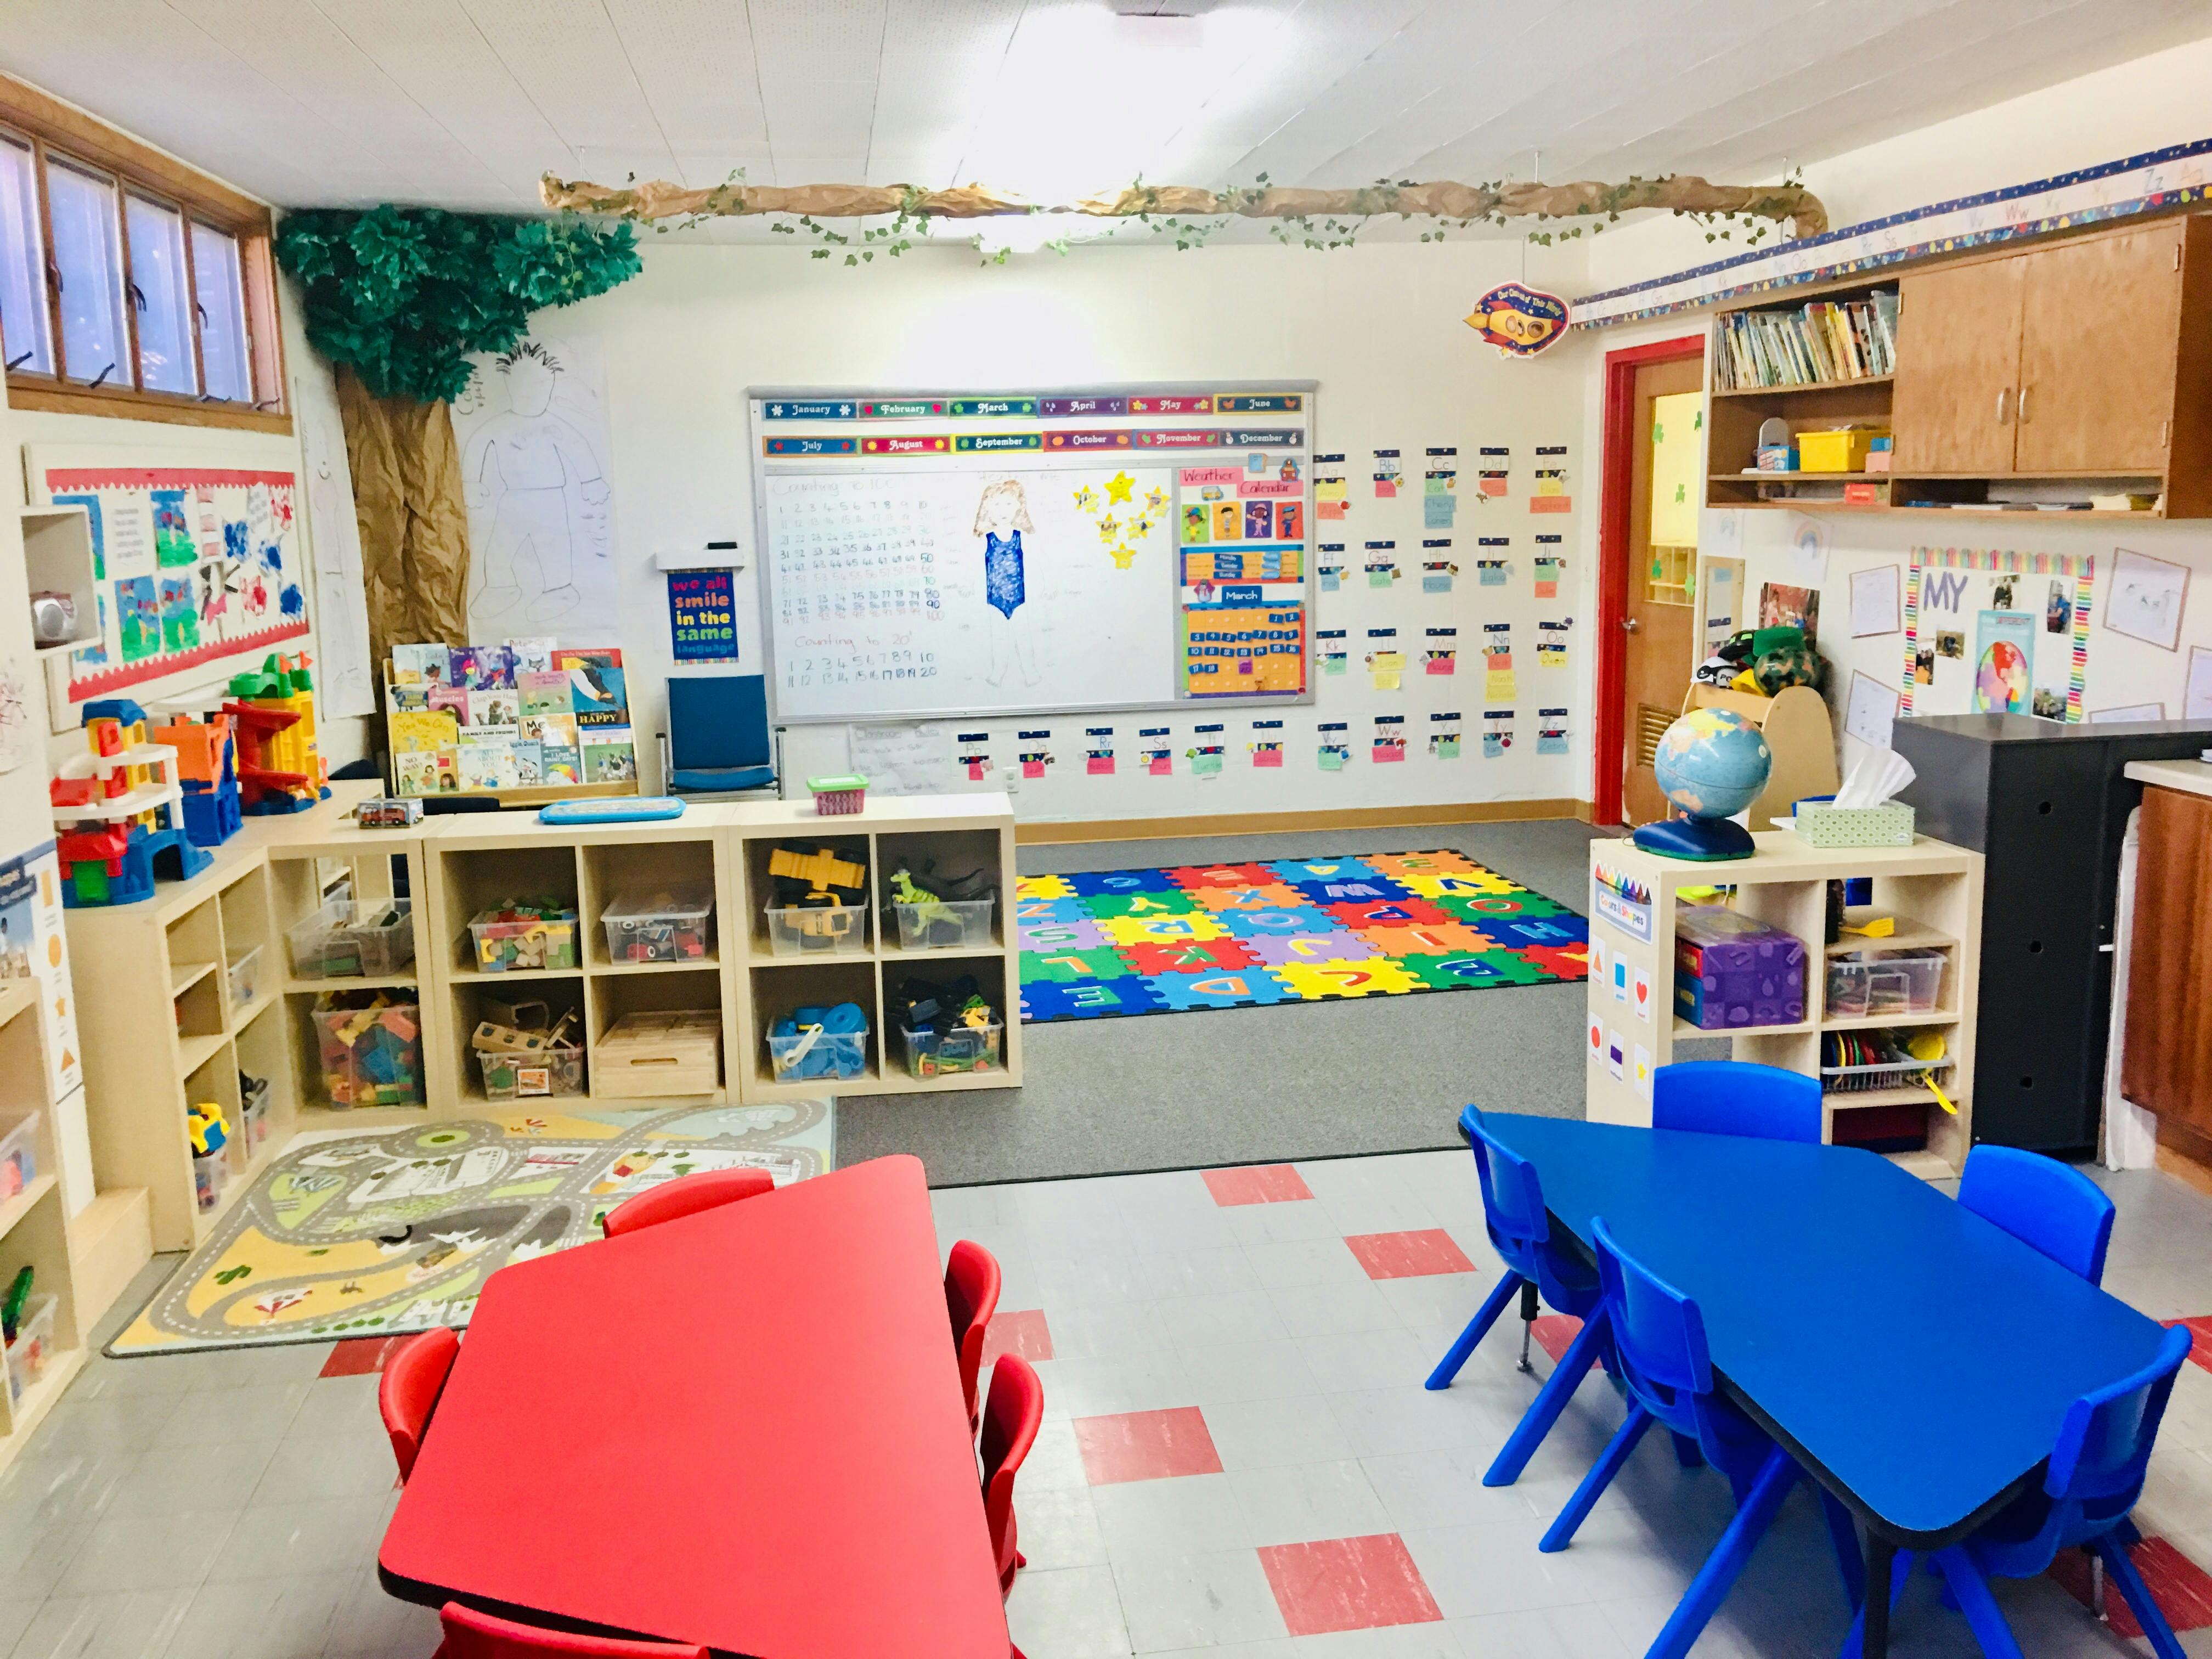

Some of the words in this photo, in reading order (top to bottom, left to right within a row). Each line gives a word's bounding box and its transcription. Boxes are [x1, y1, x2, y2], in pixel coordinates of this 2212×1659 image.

[2143, 168, 2164, 193] Zz
[792, 405, 830, 415] January
[881, 404, 926, 416] February
[978, 403, 1008, 413] March
[1070, 401, 1096, 411] April
[1160, 400, 1181, 410] May
[1249, 399, 1271, 408] June
[802, 441, 822, 452] July
[889, 439, 923, 450] August
[975, 438, 1023, 449] September
[1073, 435, 1107, 445] October
[1156, 434, 1201, 444] November
[1240, 433, 1283, 443] December
[1379, 460, 1395, 472] Bb
[1431, 458, 1449, 470] Cc
[1484, 457, 1502, 470] Dd
[1543, 456, 1558, 469] Ee
[1321, 465, 1339, 477] Aa
[1184, 469, 1233, 482] Weather
[1240, 482, 1289, 494] Calendar
[794, 503, 802, 512] 2
[809, 504, 817, 512] 3
[823, 503, 833, 512] 4
[839, 502, 848, 510] 5
[853, 501, 860, 510] 6
[884, 501, 890, 509] 8
[1368, 550, 1389, 565] Gg
[673, 579, 699, 591] we
[706, 575, 727, 589] all
[675, 591, 730, 608] smile
[1226, 590, 1258, 600] March
[1923, 572, 1968, 613] MY
[676, 610, 695, 625] in
[699, 611, 731, 624] the
[676, 627, 733, 641] same
[1493, 632, 1510, 645] Nn
[1547, 630, 1565, 644] Oo
[677, 643, 734, 654] language
[795, 634, 858, 654] Counting
[865, 635, 880, 645] to
[1325, 640, 1340, 652] Kk
[1434, 638, 1455, 650] Mm
[790, 661, 794, 672] 1
[805, 659, 815, 670] 2
[821, 658, 833, 670] 3
[838, 658, 848, 669] 4
[853, 656, 863, 666] 5
[867, 654, 875, 665] 6
[879, 653, 887, 663] 7
[891, 651, 901, 662] 8
[904, 650, 912, 661] 9
[921, 652, 934, 663] 10
[1542, 653, 1565, 665] Owen
[921, 667, 937, 678] 20
[580, 714, 617, 724] HAPPY
[1543, 716, 1559, 730] Zz
[526, 720, 546, 735] Me
[1378, 725, 1402, 737] Ww
[967, 742, 981, 755] Pp
[1100, 736, 1111, 748] Rr
[1153, 736, 1167, 749] Ss
[1221, 889, 1273, 904] X
[1129, 896, 1172, 912] Y
[1466, 898, 1525, 912] O
[1600, 894, 1617, 912] Colors
[1622, 904, 1644, 926] Shapes
[1141, 919, 1194, 934] R
[1024, 927, 1079, 944] S
[1156, 945, 1218, 965] K
[1041, 956, 1093, 973] L
[1188, 976, 1251, 995] D
[1062, 985, 1122, 1008] E
